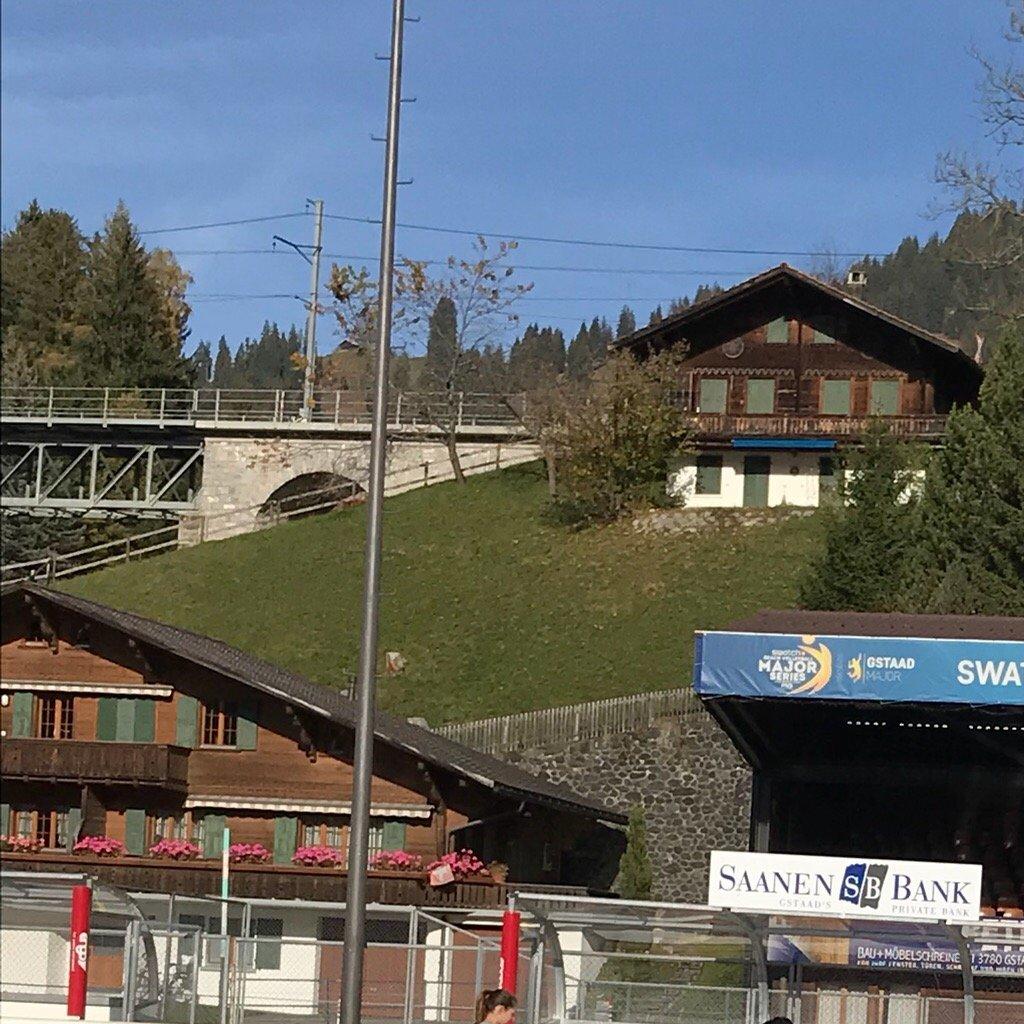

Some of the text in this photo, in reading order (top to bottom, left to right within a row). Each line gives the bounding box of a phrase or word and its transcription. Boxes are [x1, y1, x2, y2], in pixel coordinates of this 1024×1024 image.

[758, 659, 818, 674] MAJOR
[867, 656, 915, 670] GSTAAD
[769, 671, 806, 682] SERIES
[866, 671, 901, 682] MAJOR
[718, 864, 836, 897] SAANEN
[892, 873, 972, 906] BANK
[778, 898, 832, 910] GSTAAD'S
[891, 904, 970, 918] PRIVATE BANK
[979, 953, 1003, 964] 3780
